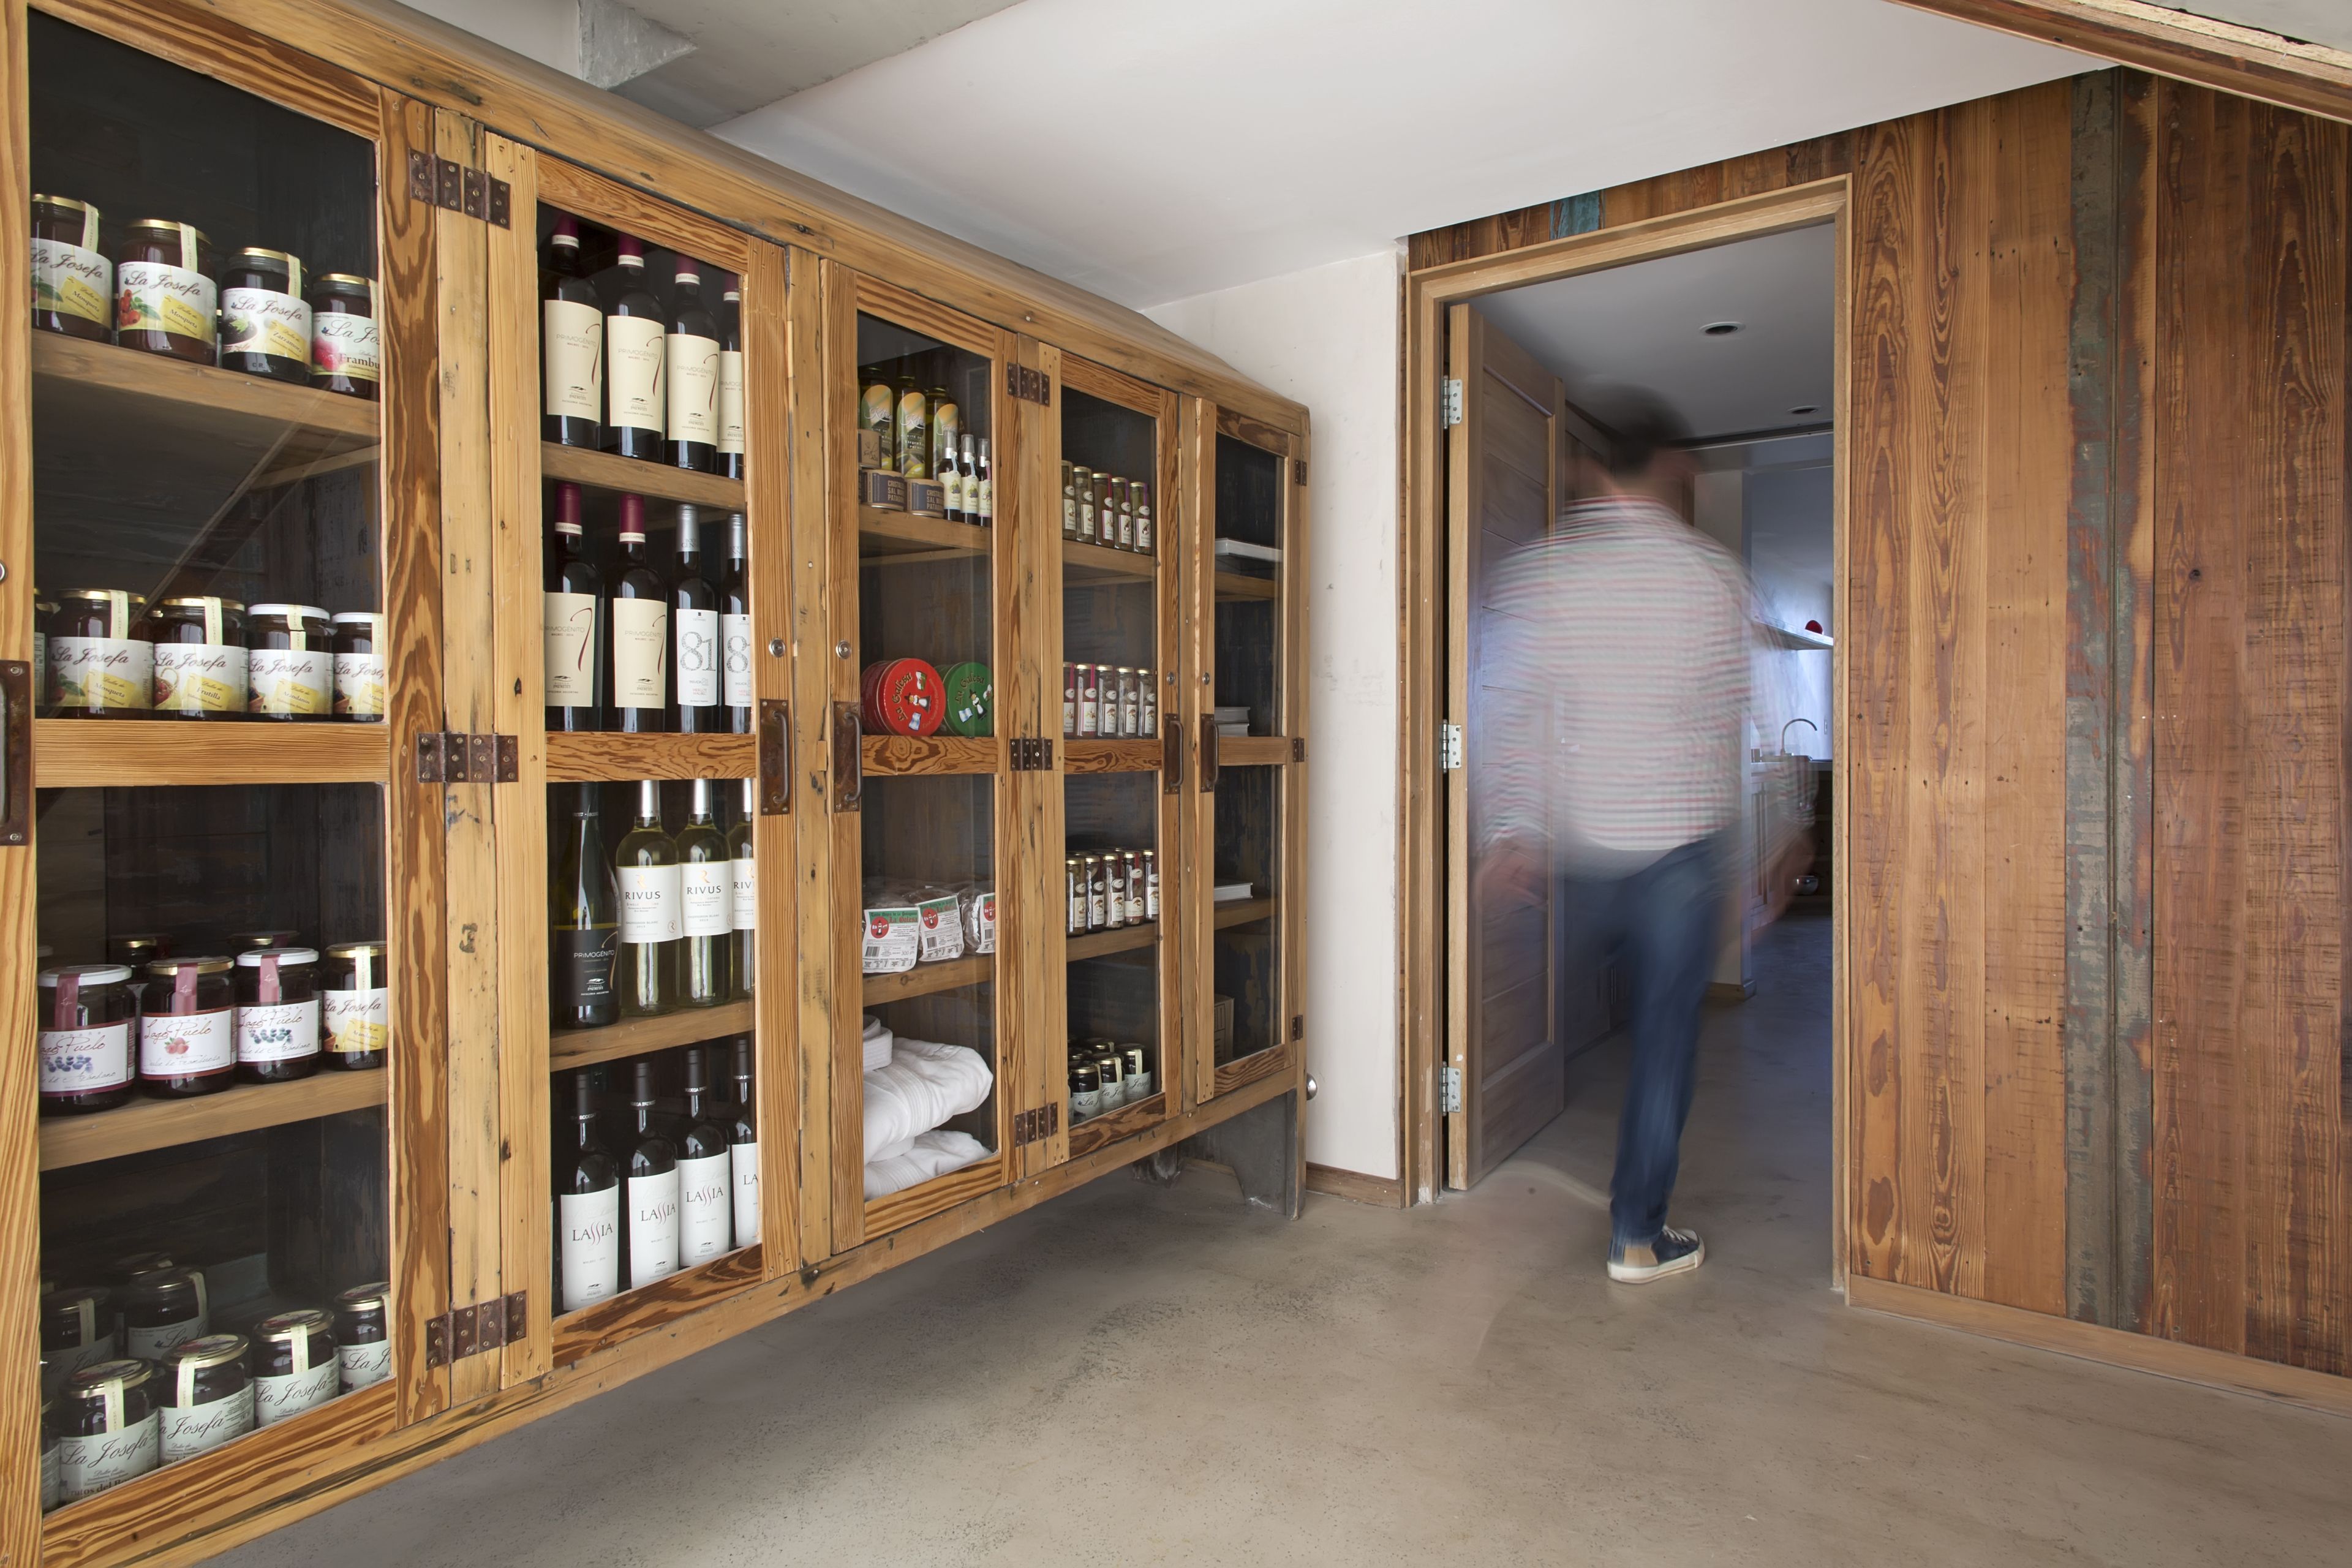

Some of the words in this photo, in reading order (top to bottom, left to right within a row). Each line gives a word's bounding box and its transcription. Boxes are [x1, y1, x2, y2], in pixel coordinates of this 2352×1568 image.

[50, 254, 102, 278] Josefa
[127, 271, 148, 285] La
[149, 274, 201, 296] Josefa
[72, 290, 99, 312] Mosqueta
[235, 296, 255, 310] La
[257, 300, 303, 320] Josefa
[170, 309, 198, 329] Mosqueta
[325, 320, 353, 337] La
[273, 331, 303, 353] Zarzamora
[52, 646, 73, 662] La
[73, 648, 129, 667] Josefa
[154, 652, 174, 666] La
[175, 653, 227, 671] Josefa
[680, 631, 715, 671] 81
[726, 636, 751, 673] 8
[249, 658, 265, 672] La
[265, 658, 313, 676] Josefa
[334, 662, 351, 675] La
[94, 683, 126, 698] Mosqueta
[892, 672, 913, 704] Galesa
[960, 671, 985, 689] Galesa
[197, 687, 221, 700] Frutilla
[895, 706, 908, 722] La
[625, 891, 661, 900] RIVUS
[687, 886, 722, 895] RIVUS
[325, 998, 336, 1012] La
[337, 998, 382, 1015] Josefa
[239, 1008, 263, 1032] Lago
[261, 1009, 303, 1026] Puelo
[144, 1019, 169, 1044] Lago
[167, 1020, 212, 1038] Puelo
[56, 1035, 106, 1053] Puelo
[686, 1185, 723, 1206] LASSIA
[641, 1200, 676, 1225] LASSIA
[573, 1221, 614, 1245] LASSIA
[344, 1352, 371, 1370] La
[256, 1384, 274, 1403] La
[274, 1373, 327, 1406] Josefa
[167, 1410, 225, 1439] Josefa
[61, 1445, 88, 1465] La
[88, 1430, 148, 1468] Josefa
[66, 1486, 94, 1496] Frutos
